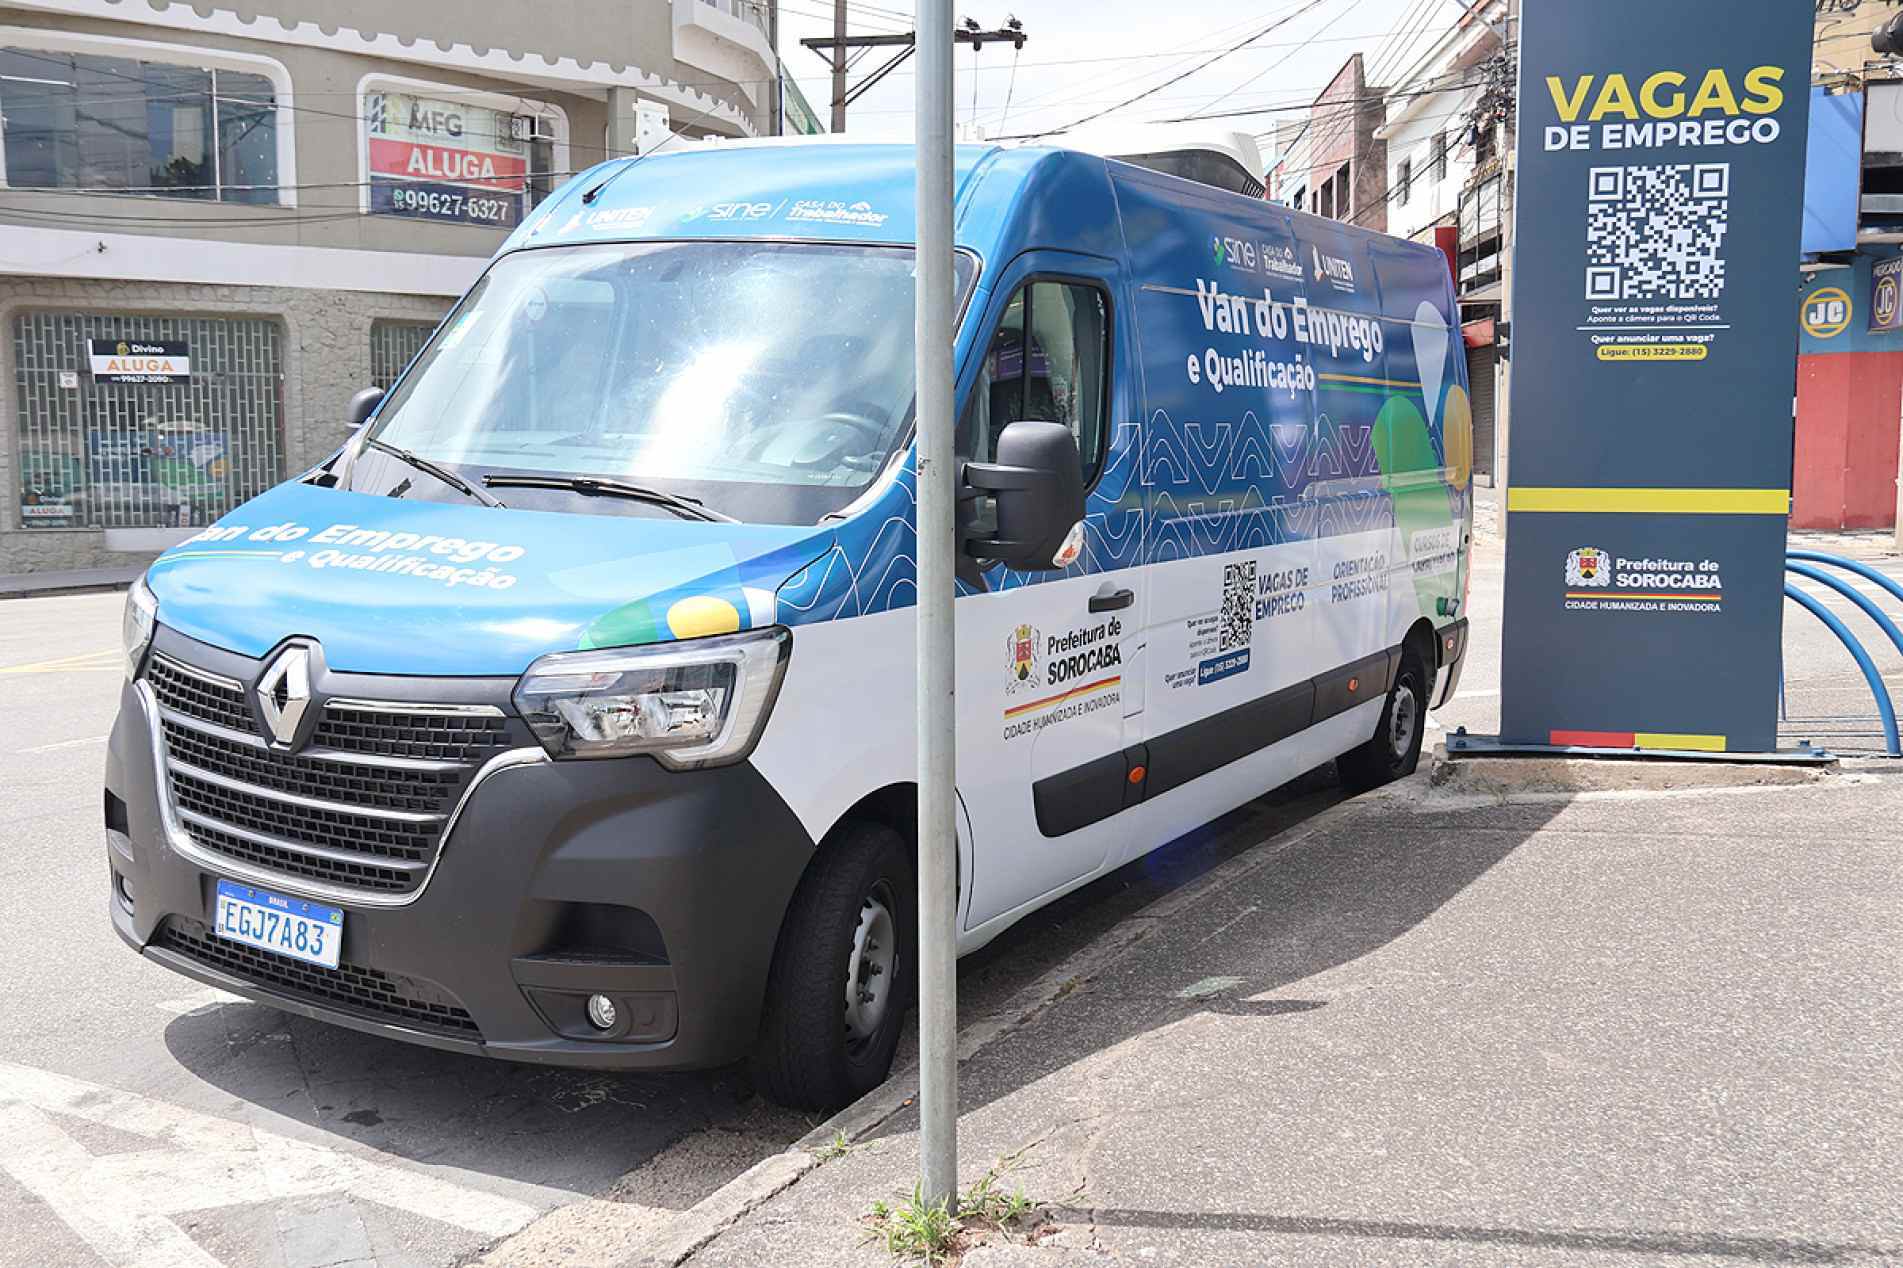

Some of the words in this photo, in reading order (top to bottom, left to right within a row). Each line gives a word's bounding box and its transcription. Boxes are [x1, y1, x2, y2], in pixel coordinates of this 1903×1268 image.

[1545, 65, 1785, 122] VAGAS
[409, 109, 463, 136] MFG
[1544, 125, 1590, 151] DE
[1602, 118, 1780, 149] EMPREGO
[408, 148, 496, 183] ALUGA
[405, 190, 508, 221] 99627-6327
[708, 201, 772, 219] sine
[790, 206, 888, 224] Trabalhador
[1224, 237, 1256, 267] sine
[1592, 306, 1612, 315] Quer
[1640, 306, 1664, 315] vagas
[1809, 301, 1844, 324] JC
[1877, 286, 1893, 314] JC
[1197, 279, 1250, 335] Van
[1255, 288, 1288, 340] do
[1292, 296, 1383, 362] Emprego
[1587, 315, 1616, 323] Aponte
[1657, 315, 1675, 324] para
[1683, 315, 1697, 323] QR
[131, 344, 165, 354] Divino
[1591, 335, 1615, 345] Quer
[1617, 334, 1660, 343] anunciar
[1686, 334, 1715, 344] vaga?
[1632, 348, 1650, 357] (15)
[106, 359, 174, 372] ALUGA
[1187, 354, 1200, 384] e
[1205, 348, 1315, 399] Qualificação
[248, 522, 310, 542] do
[308, 524, 526, 563] Emprego
[280, 550, 305, 563] e
[308, 549, 519, 590] Qualificação
[1333, 551, 1386, 580] ORIENTAÇÃO
[1615, 558, 1694, 572] Prefeitura
[1698, 559, 1720, 571] de
[1258, 570, 1293, 596] VAGAS
[1295, 567, 1309, 587] DE
[1331, 573, 1390, 604] PROFISSIONAL
[1615, 574, 1722, 588] SOROCABA
[1564, 600, 1598, 610] CIDADE
[1600, 601, 1657, 611] HUMANIZADA
[1659, 602, 1666, 611] E
[1668, 602, 1721, 613] INOVADORA
[1047, 624, 1105, 655] Prefeitura
[1108, 616, 1121, 636] de
[1047, 643, 1122, 685] SOROCABA
[1003, 719, 1031, 741] CIDADE
[1033, 705, 1076, 729] HUMANIZADA
[1085, 692, 1120, 713] INOVADORA
[226, 901, 325, 956] EGJ7A83
